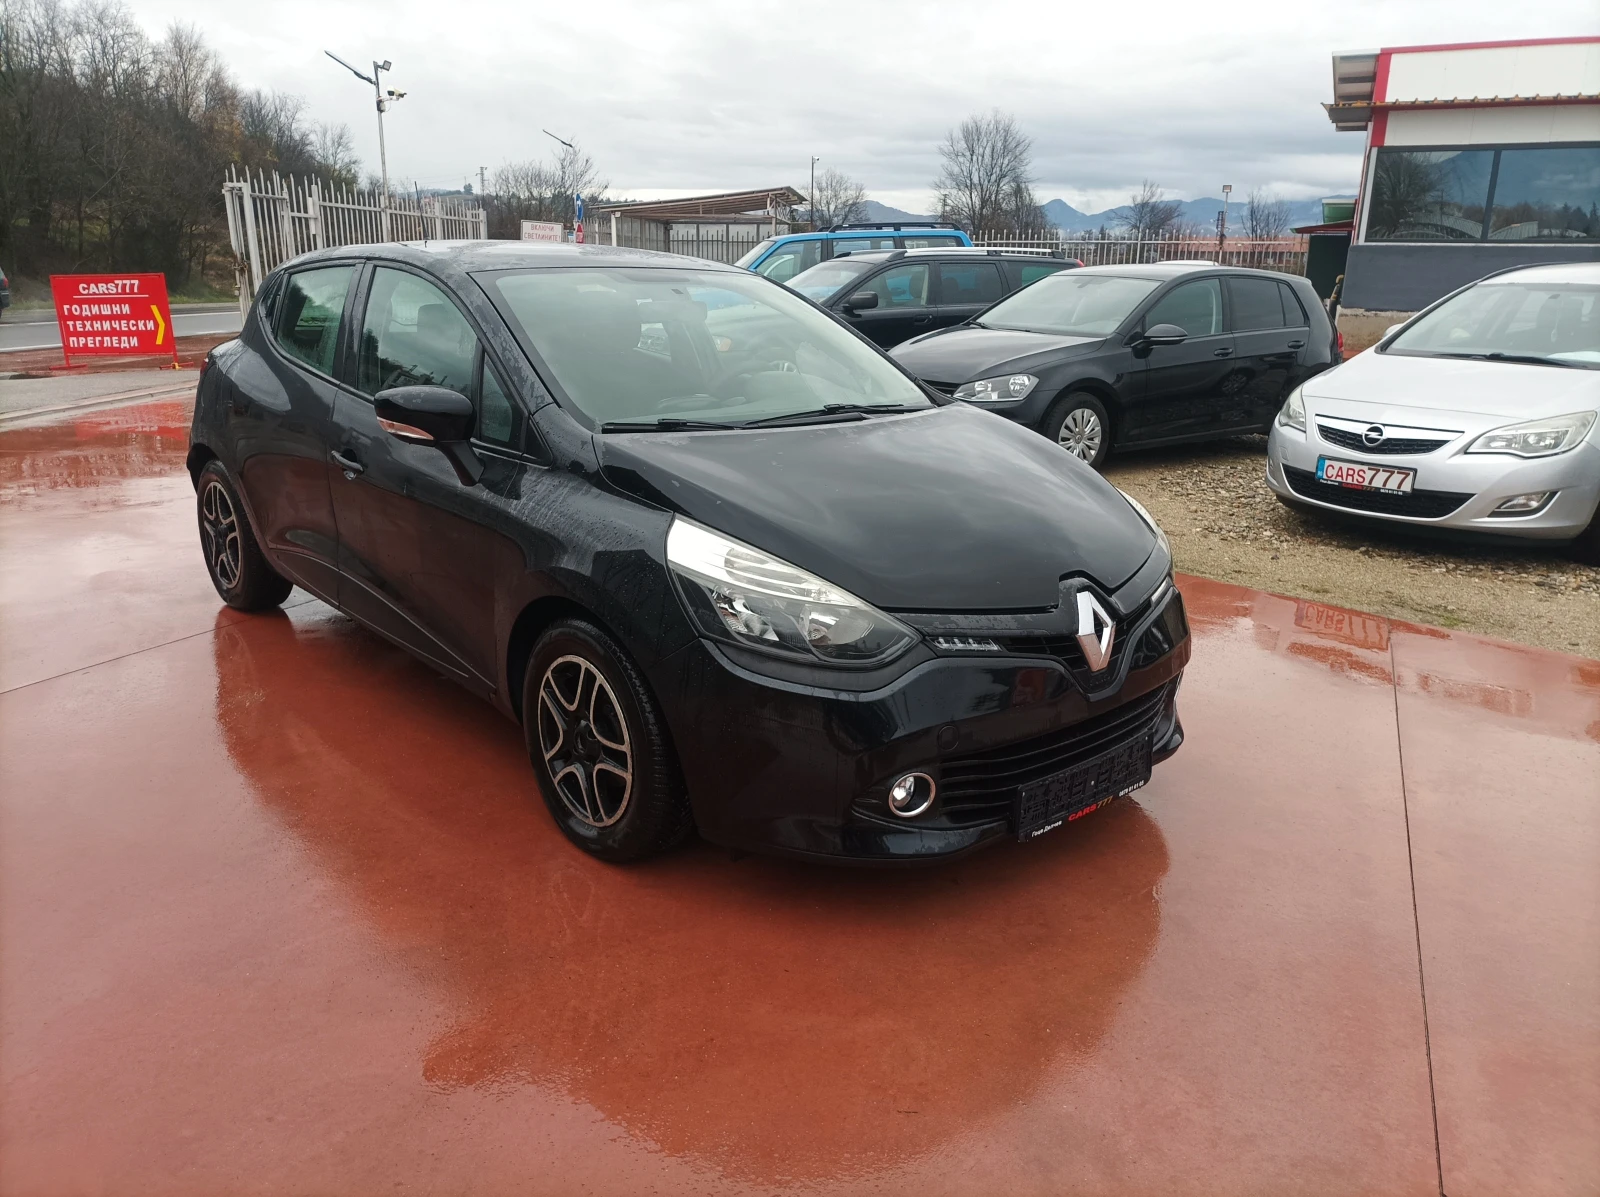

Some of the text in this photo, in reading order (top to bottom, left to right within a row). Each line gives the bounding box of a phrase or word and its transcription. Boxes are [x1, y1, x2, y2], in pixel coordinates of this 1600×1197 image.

[530, 223, 555, 232] ВКЛЮЧИ
[78, 279, 140, 295] CARS777
[63, 303, 131, 317] ГОДИШНИ
[66, 319, 155, 331] ТЕХНИЧЕСКИ
[69, 335, 139, 349] ПРЕГЛЕДИ
[1325, 464, 1411, 490] CARS777
[1068, 795, 1114, 822] CARS777
